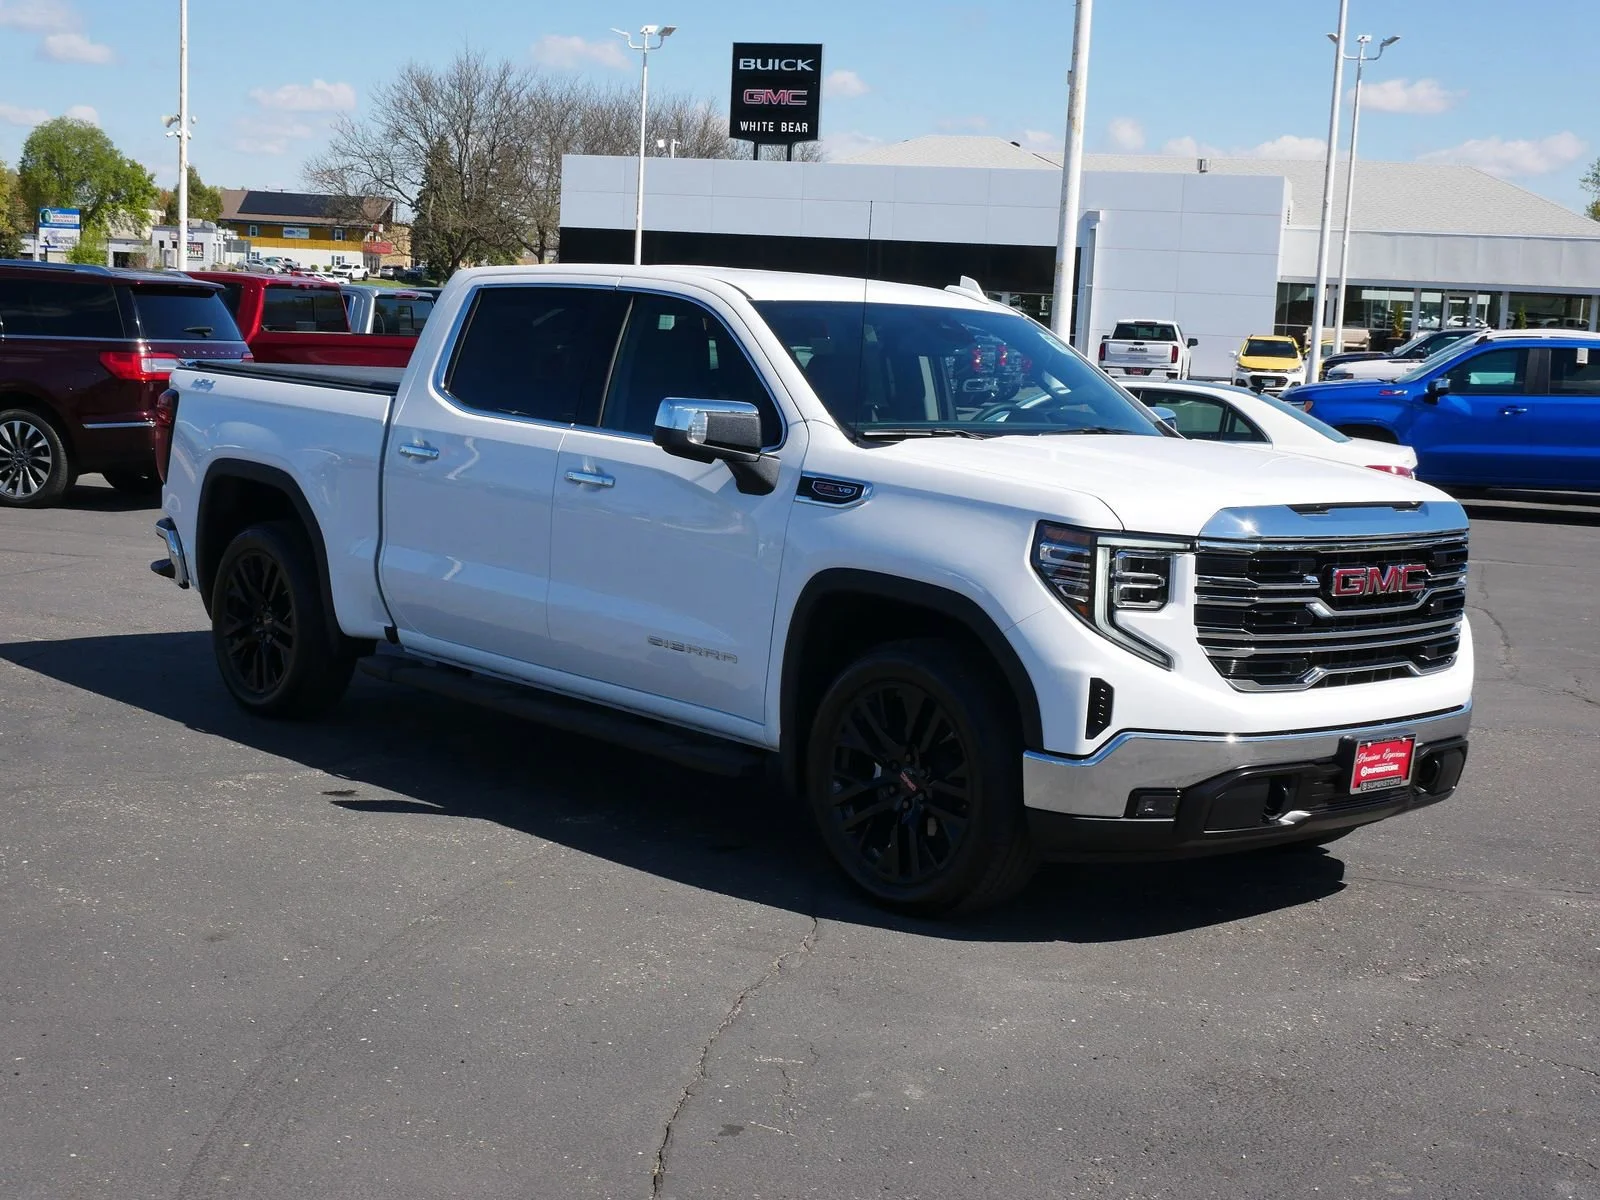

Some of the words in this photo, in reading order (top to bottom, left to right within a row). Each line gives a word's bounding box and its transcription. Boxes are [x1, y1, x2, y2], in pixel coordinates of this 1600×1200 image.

[739, 58, 814, 71] BUICK
[743, 88, 808, 105] GMC
[740, 121, 774, 132] WHITE
[781, 122, 808, 133] BEAR
[1331, 563, 1427, 597] GMC
[647, 634, 738, 664] SIERRA
[1367, 777, 1400, 788] SUPERSTORE
